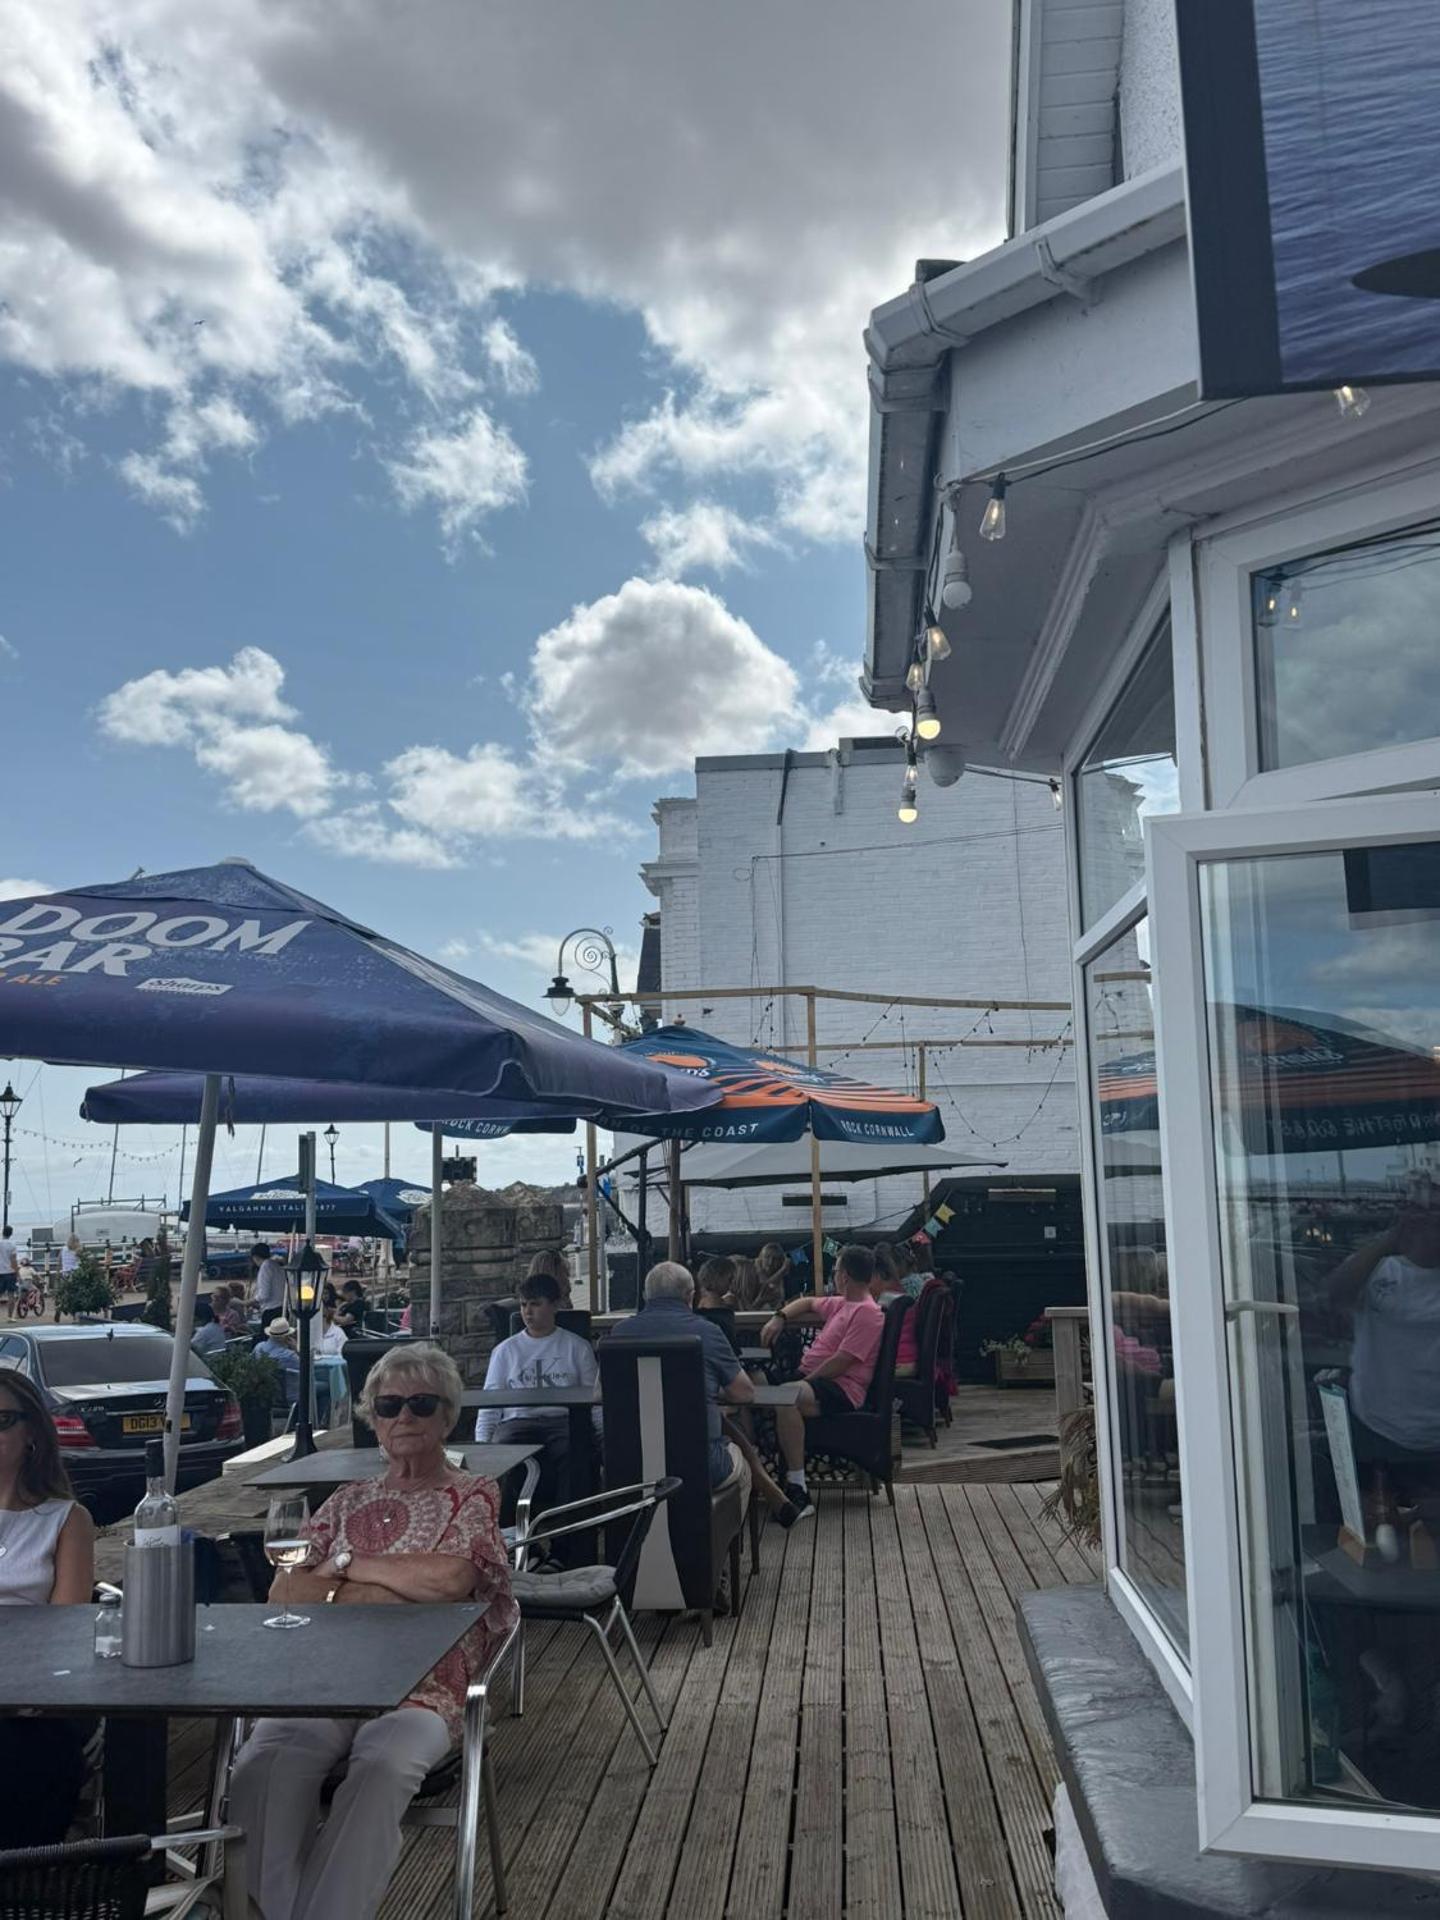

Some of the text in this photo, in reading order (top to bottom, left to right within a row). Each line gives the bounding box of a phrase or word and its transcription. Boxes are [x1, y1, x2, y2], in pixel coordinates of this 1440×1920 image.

[0, 903, 313, 954] DOOM
[6, 973, 68, 986] ALE
[661, 1127, 695, 1138] THE
[702, 1123, 759, 1138] COAST
[863, 1123, 915, 1137] CORNWALL
[277, 1204, 306, 1212] ITALI
